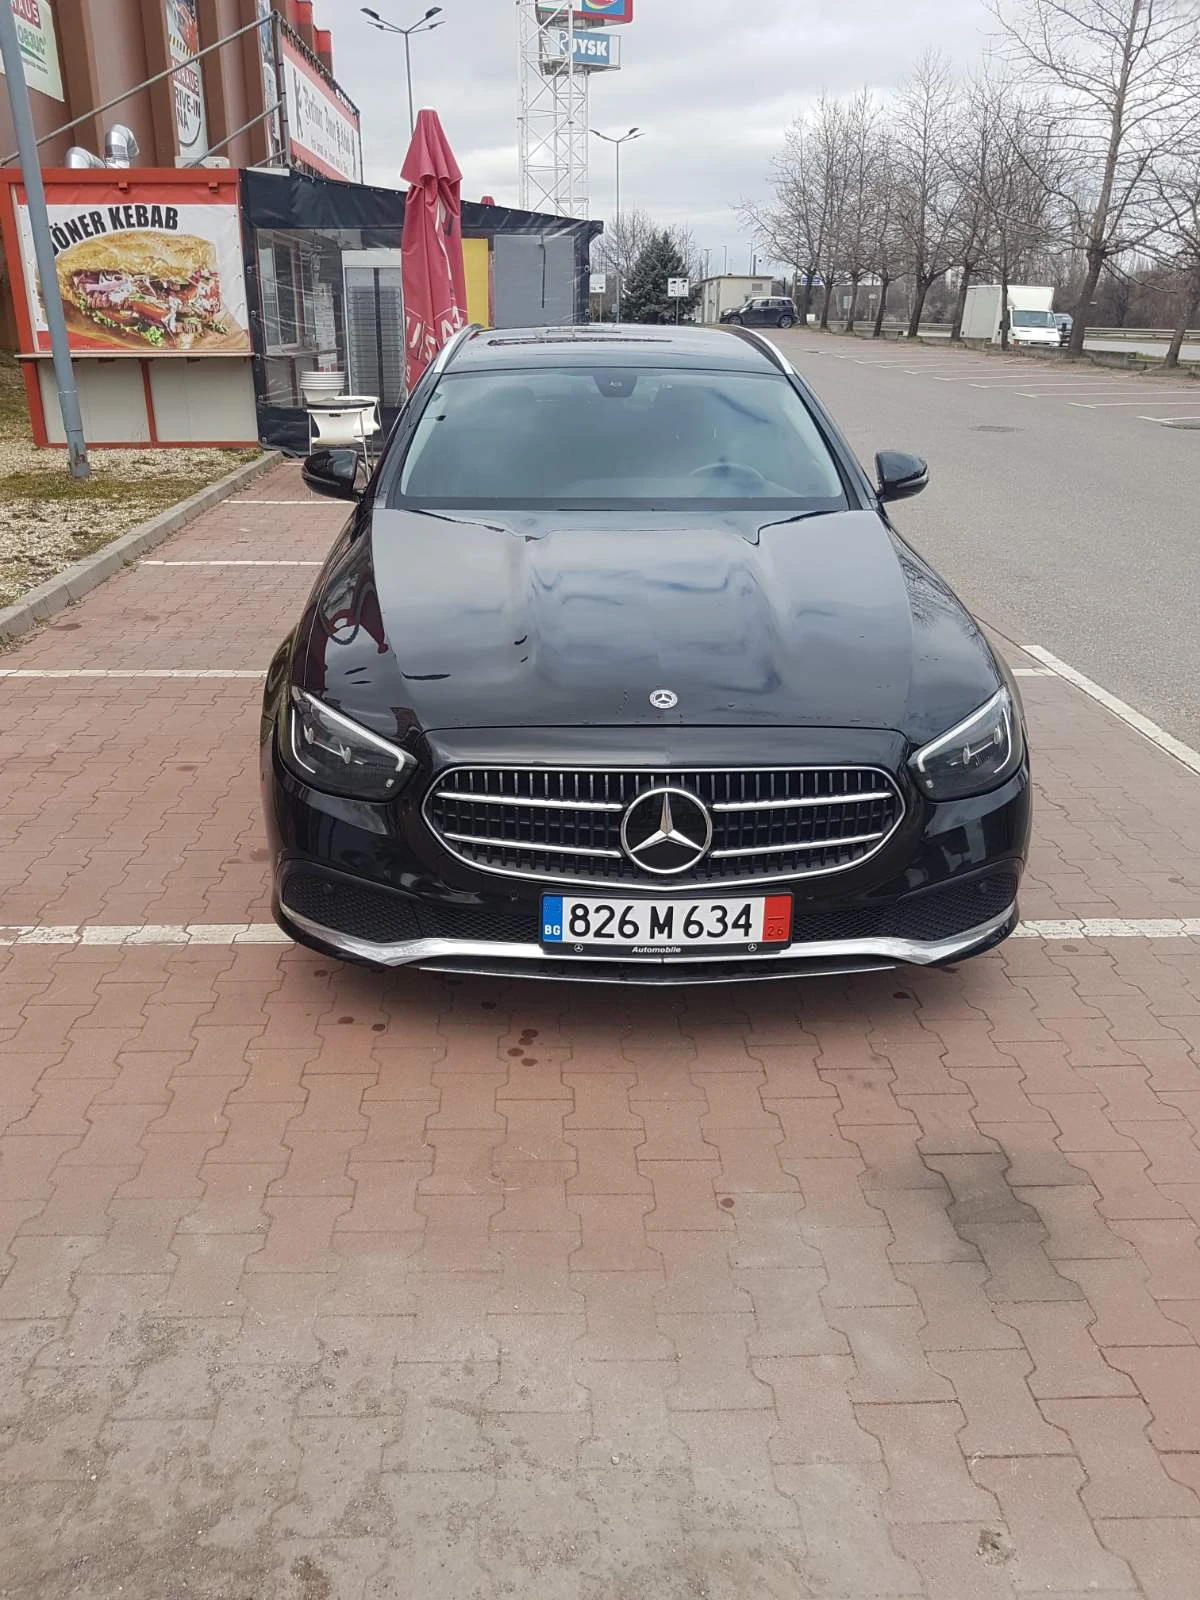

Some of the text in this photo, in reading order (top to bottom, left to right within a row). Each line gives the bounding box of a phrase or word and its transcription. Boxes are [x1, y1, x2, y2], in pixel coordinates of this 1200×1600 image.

[571, 39, 608, 56] JYSK
[108, 205, 178, 230] KEBAB
[569, 904, 752, 939] 826 M 634
[544, 925, 561, 935] BG
[768, 925, 784, 937] 26
[632, 945, 682, 954] Automobile
